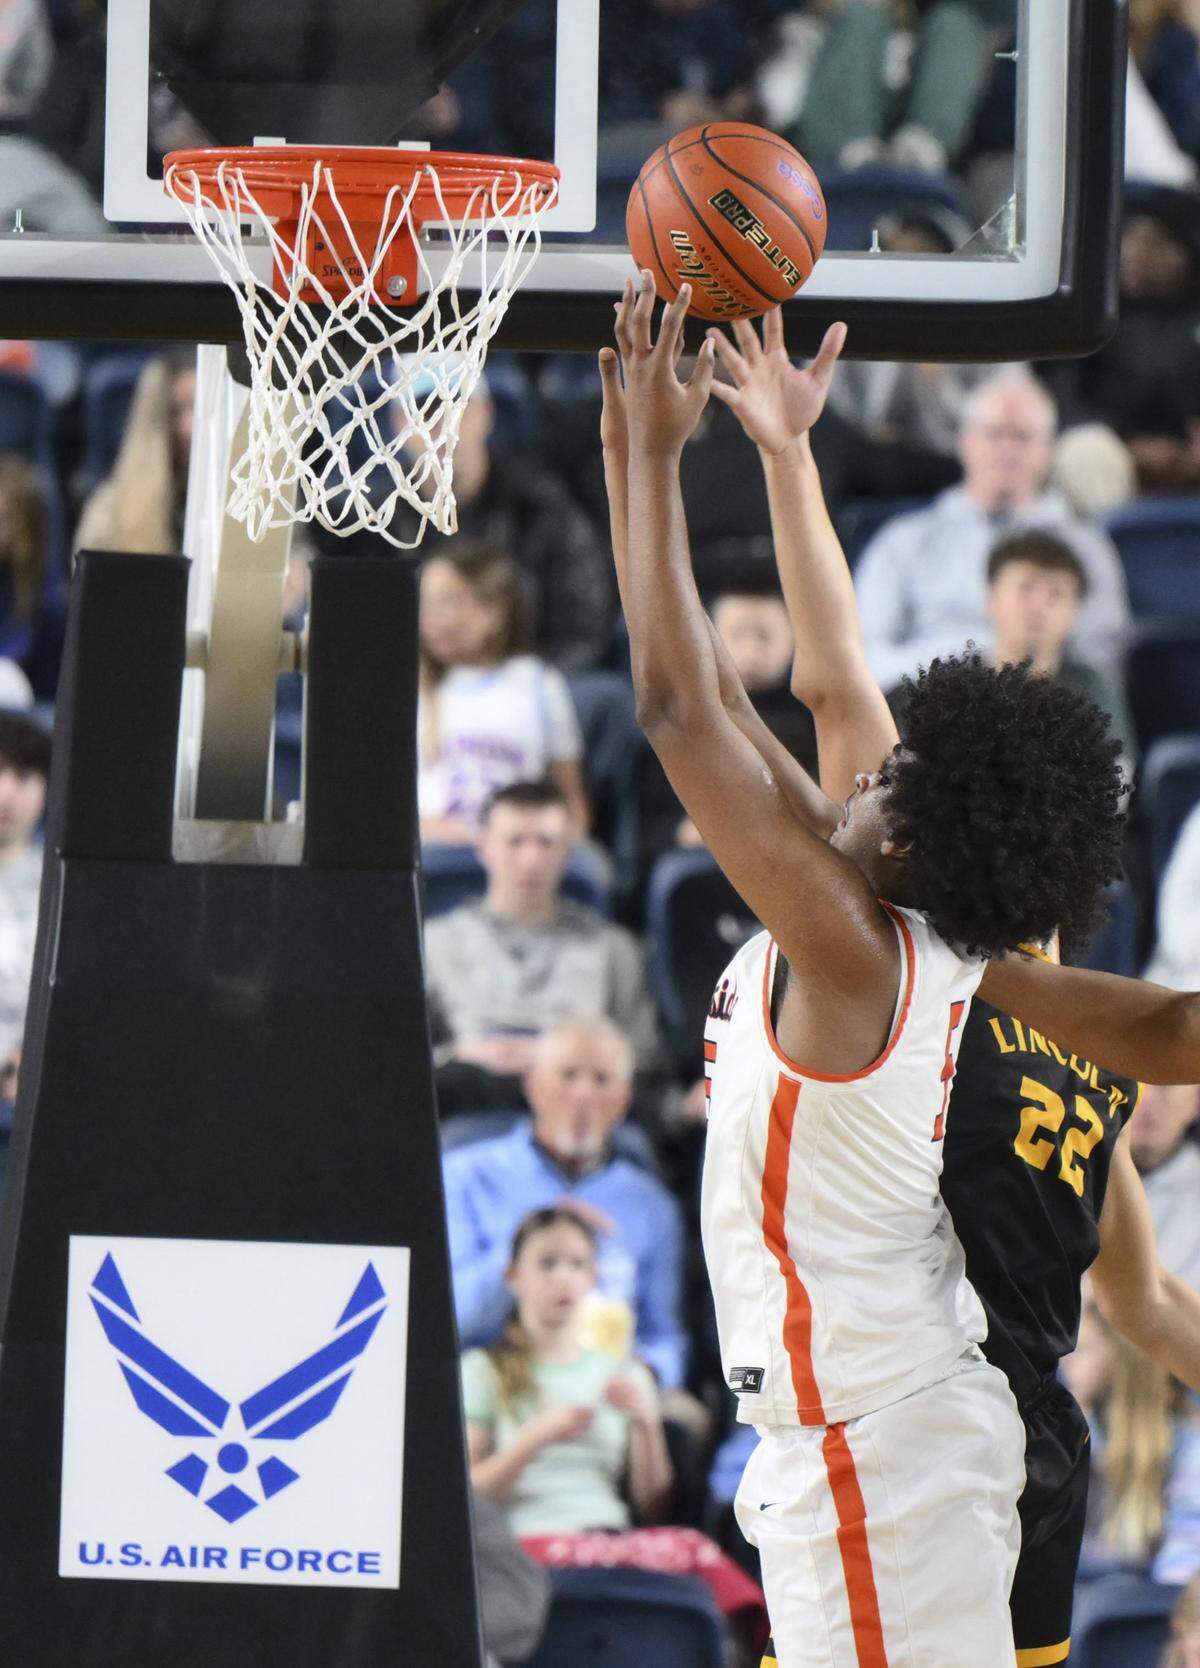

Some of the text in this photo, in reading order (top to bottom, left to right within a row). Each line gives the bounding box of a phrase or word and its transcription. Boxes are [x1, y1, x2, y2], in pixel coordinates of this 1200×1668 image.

[1013, 1075, 1105, 1198] 22
[744, 1374, 757, 1385] XL
[79, 1542, 382, 1575] U.S. AIR FORCE
